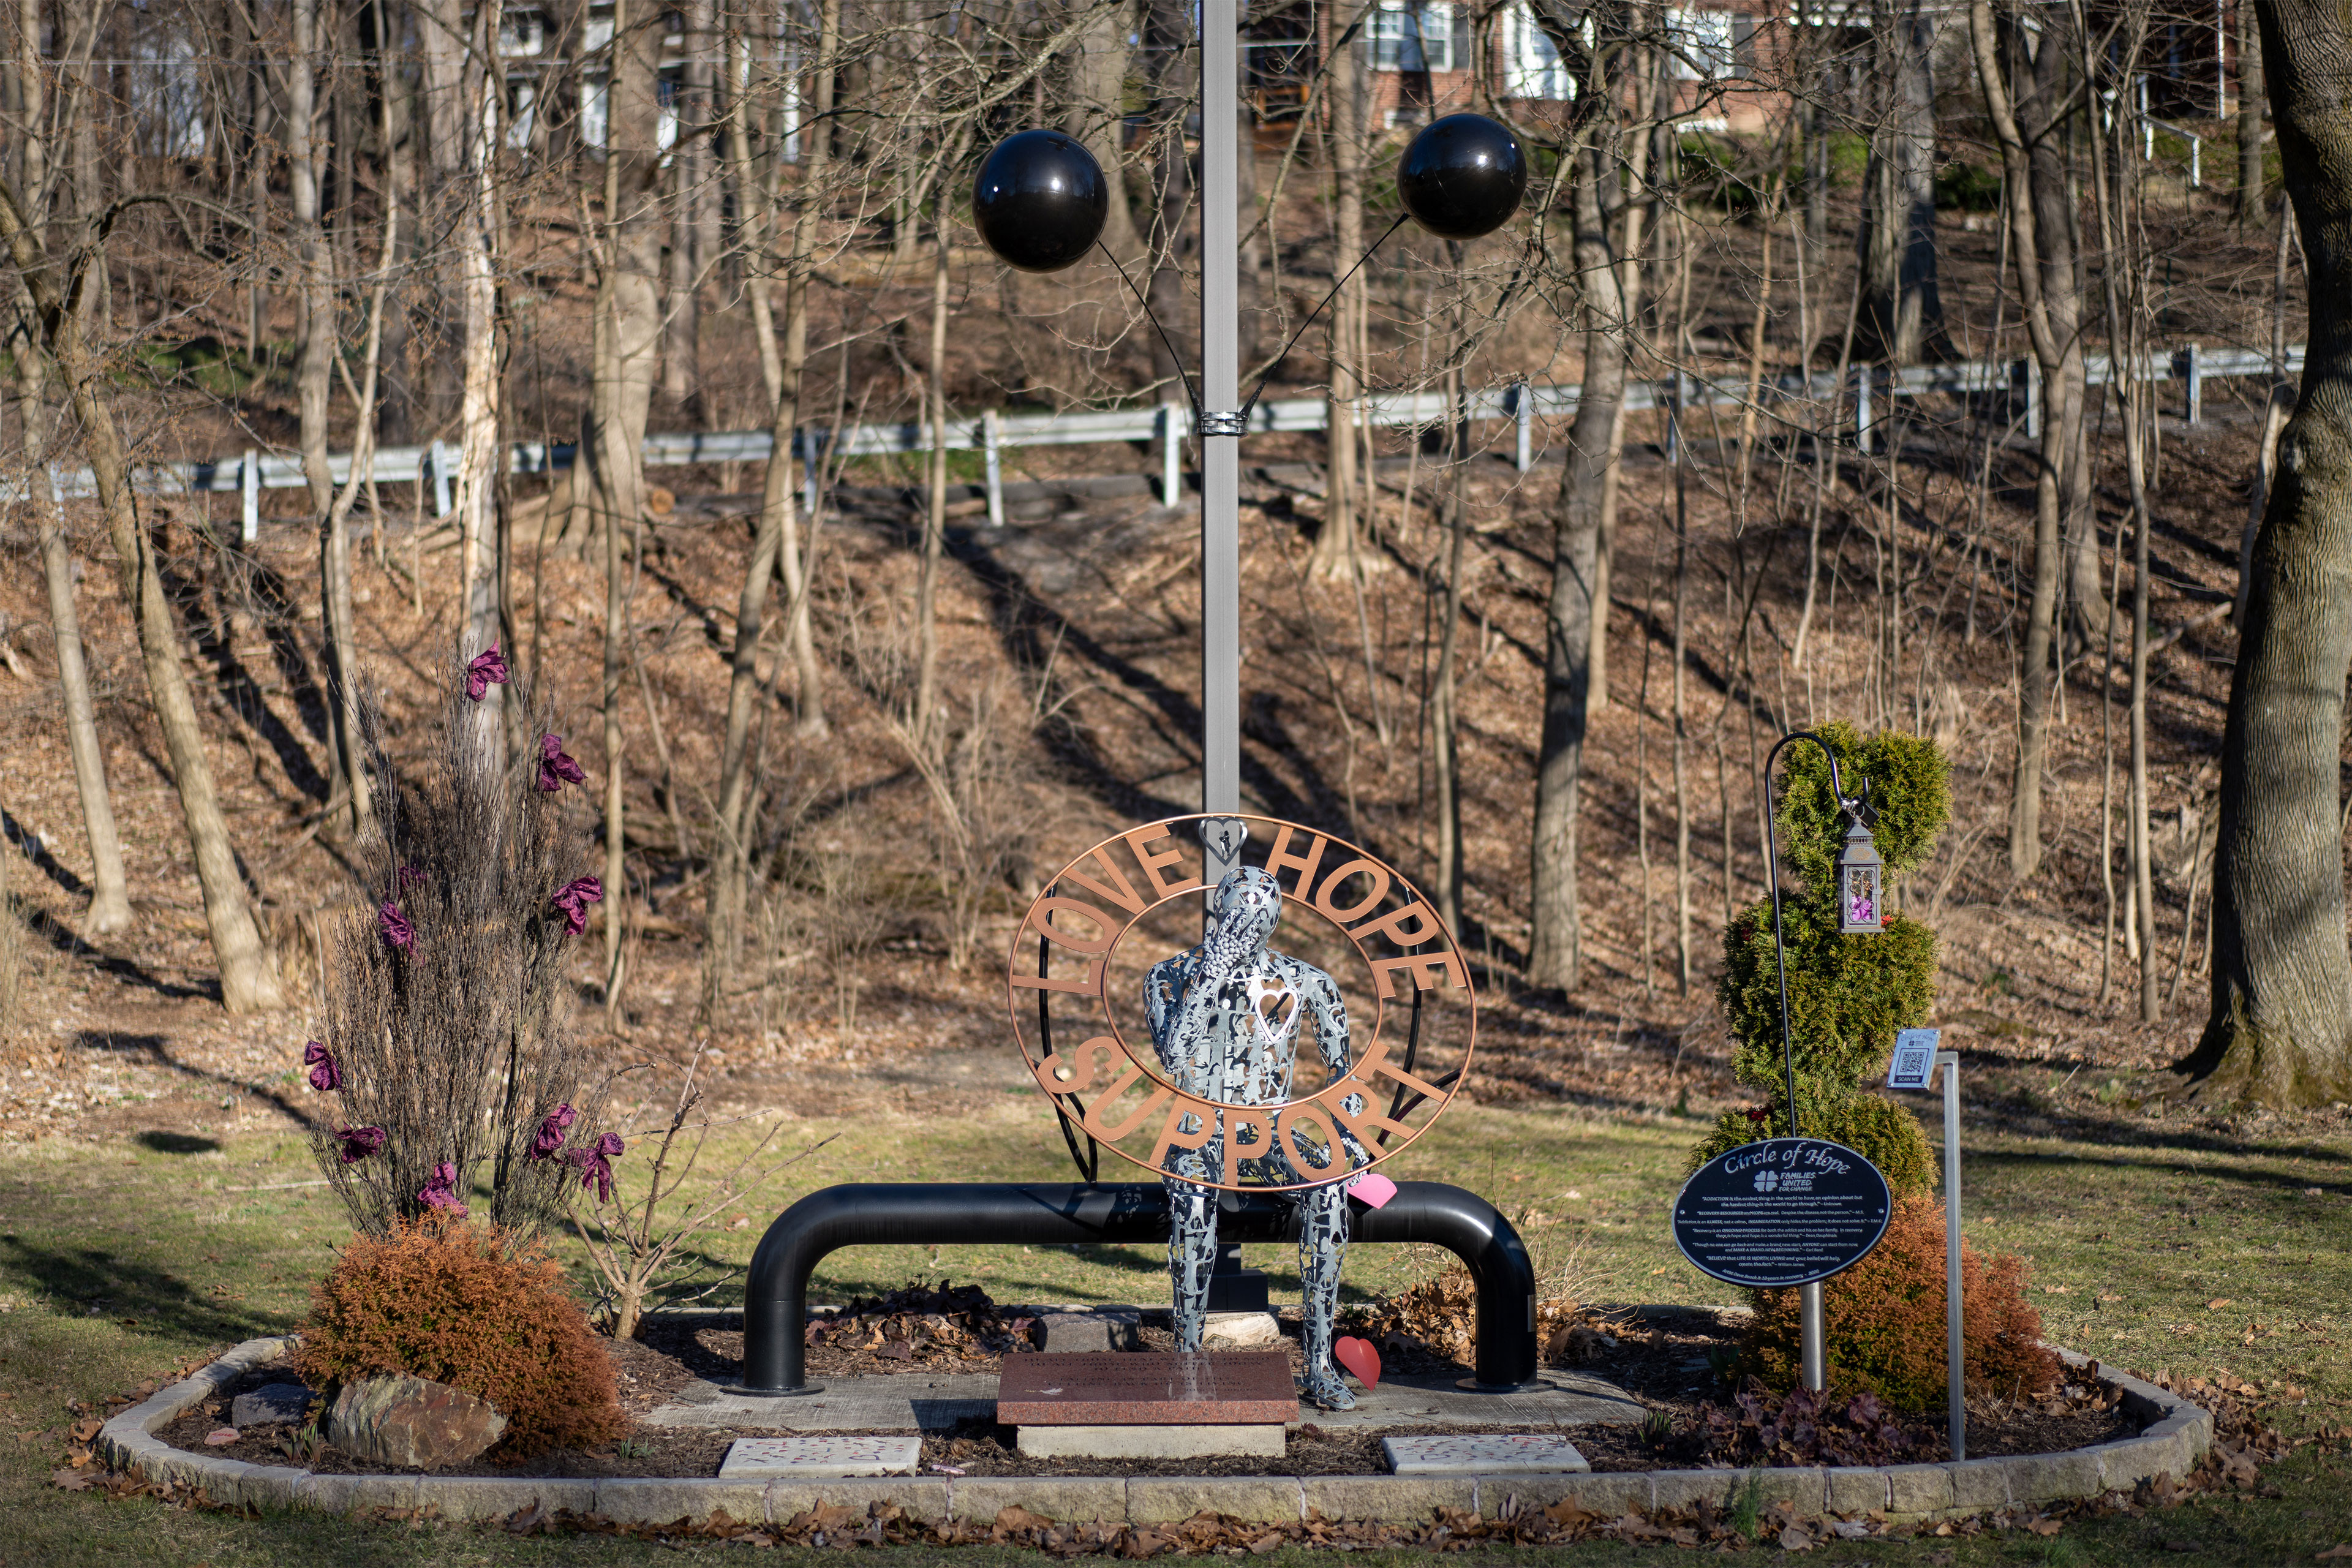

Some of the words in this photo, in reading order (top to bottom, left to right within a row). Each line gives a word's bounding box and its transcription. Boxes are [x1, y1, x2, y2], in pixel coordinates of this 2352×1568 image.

[1012, 823, 1201, 997] LOVE
[1265, 824, 1468, 998] HOPE
[1038, 1036, 1448, 1186] SUPPORT
[1725, 1143, 1776, 1174] Circle
[1782, 1142, 1807, 1169] of
[1804, 1147, 1850, 1174] Hope
